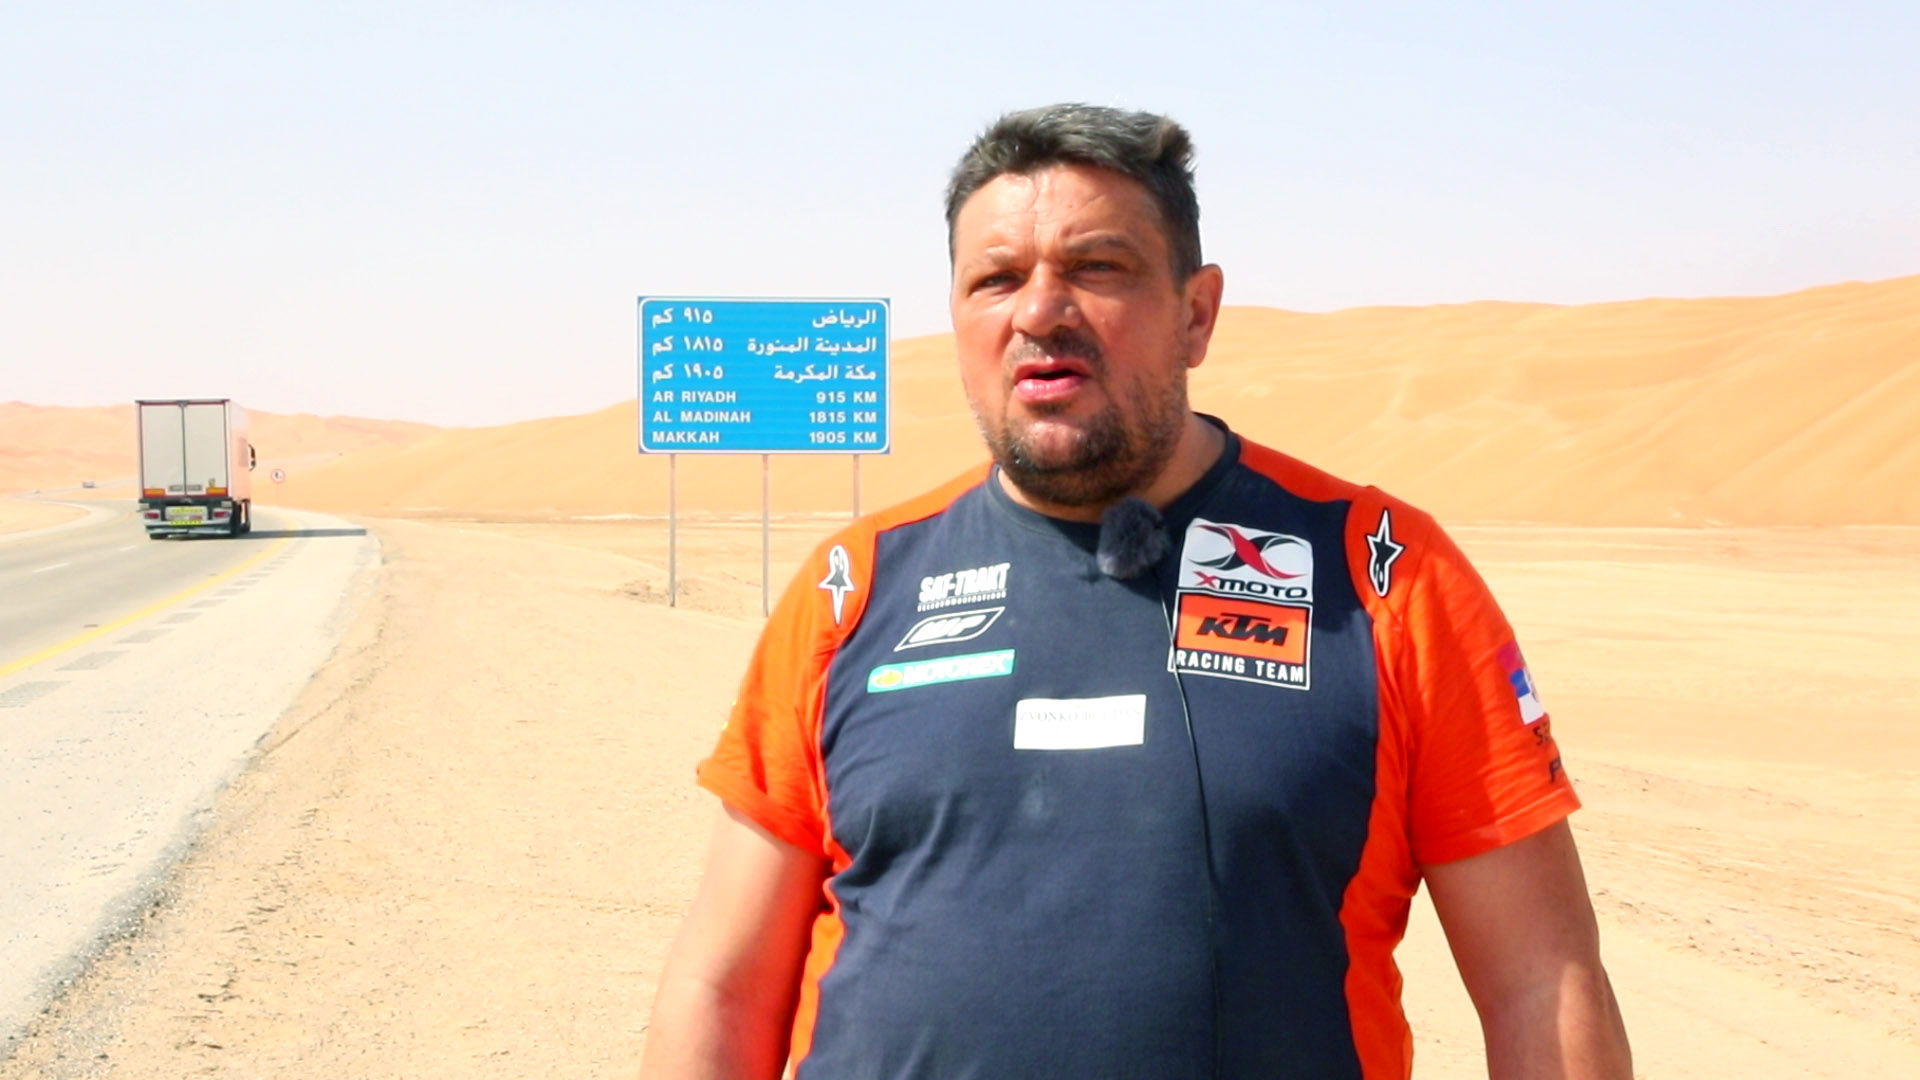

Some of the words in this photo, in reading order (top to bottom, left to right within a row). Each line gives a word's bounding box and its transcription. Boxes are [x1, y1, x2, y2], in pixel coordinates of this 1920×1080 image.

[652, 307, 674, 329] كم
[683, 308, 713, 324] ٩١٥
[812, 309, 877, 328] الرياض
[652, 335, 674, 356] كم
[684, 336, 723, 352] ١٨١٥
[747, 337, 809, 356] المنورة
[815, 337, 877, 356] المدينة
[652, 363, 674, 384] كم
[684, 363, 723, 379] ١٩٠٥
[773, 364, 838, 383] المكرمة
[844, 364, 877, 381] مكة
[653, 391, 674, 403] AR
[681, 391, 736, 403] RIYADH
[816, 391, 846, 403] 915
[853, 391, 877, 403] KM
[653, 411, 672, 423] AL
[681, 411, 751, 423] MADINAH
[809, 411, 846, 423] 1815
[853, 411, 877, 423] KM
[652, 431, 720, 443] MAKKAH
[809, 431, 846, 443] 1905
[853, 431, 877, 443] KM
[1195, 612, 1289, 647] KTM
[903, 654, 1007, 685] MOTOREX
[1175, 650, 1245, 674] RACING
[1255, 660, 1304, 683] TEAM
